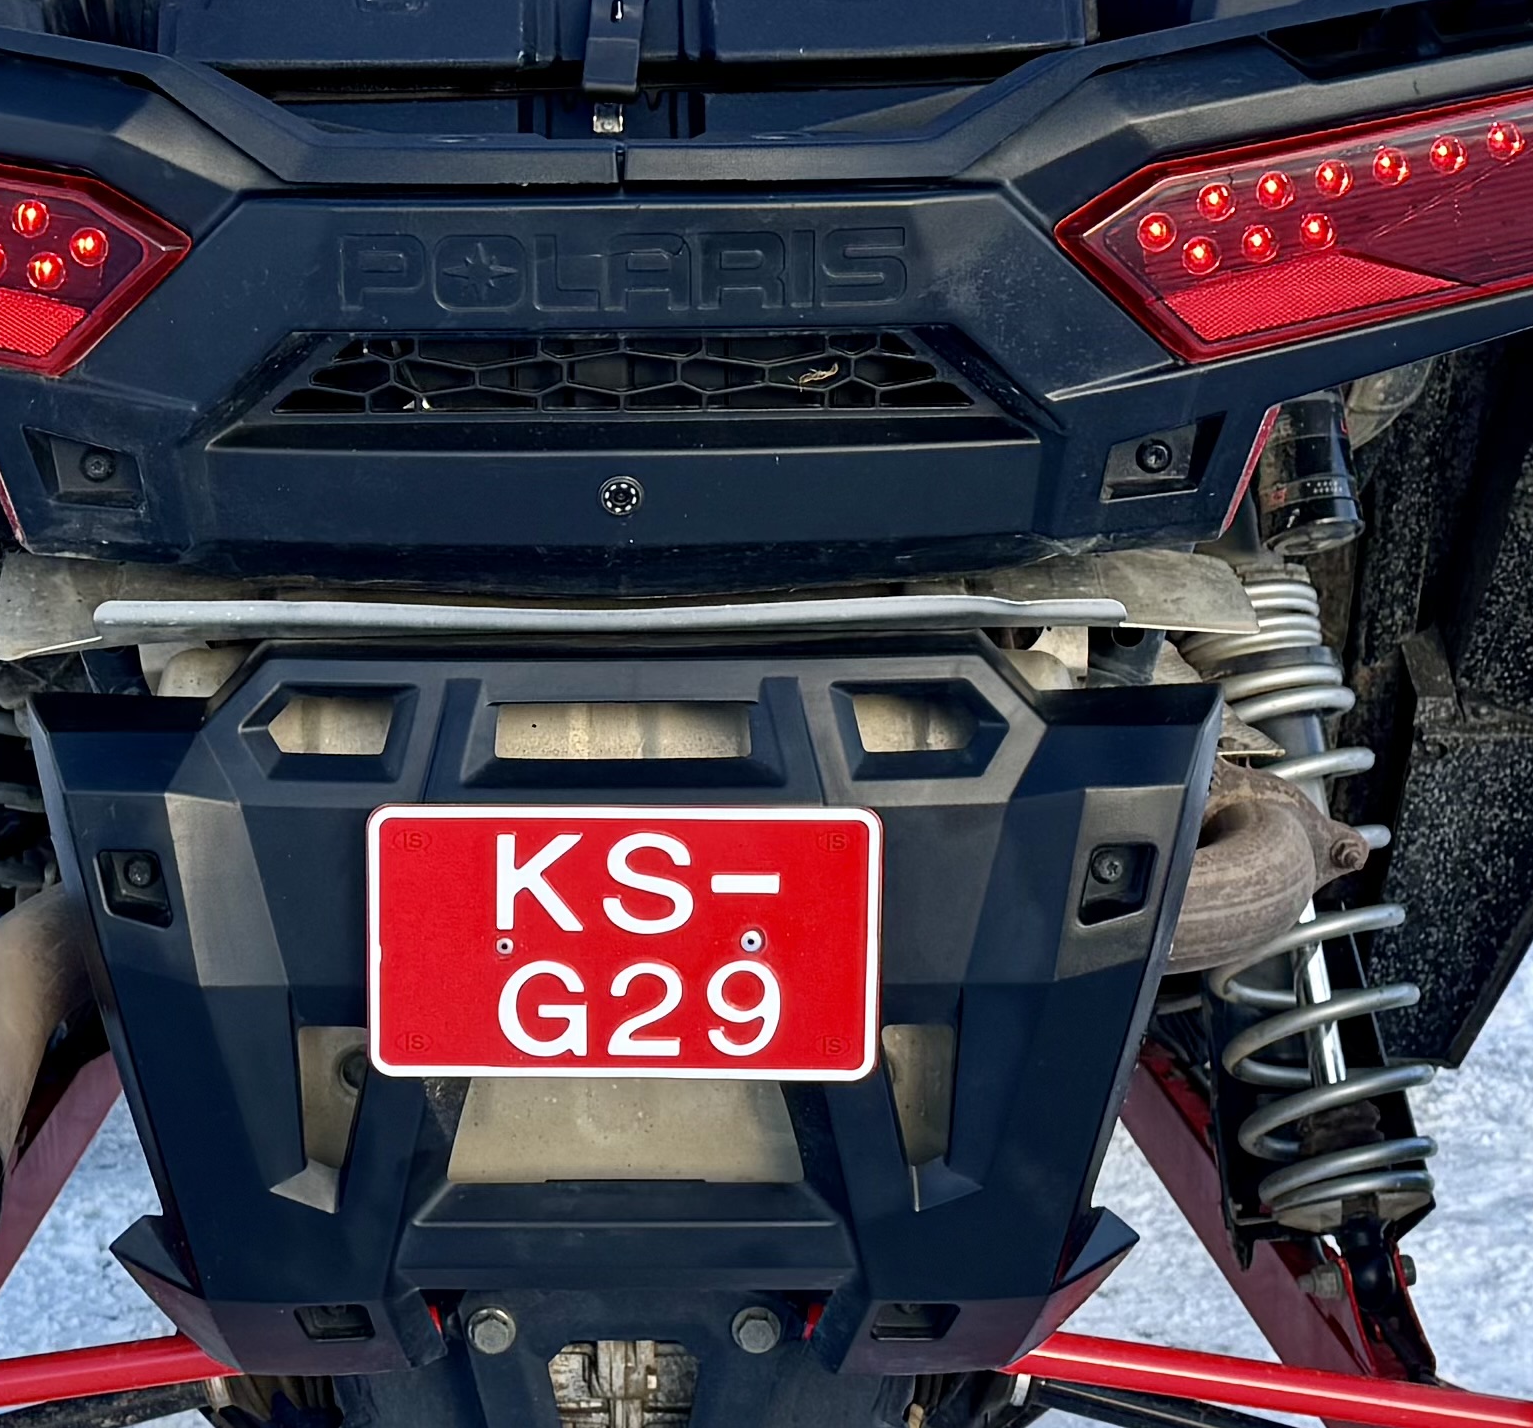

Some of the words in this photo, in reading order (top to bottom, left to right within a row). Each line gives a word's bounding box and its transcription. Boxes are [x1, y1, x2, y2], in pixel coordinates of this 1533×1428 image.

[338, 226, 908, 312] POLARIS
[495, 832, 781, 934] KS-
[497, 960, 782, 1058] G29
